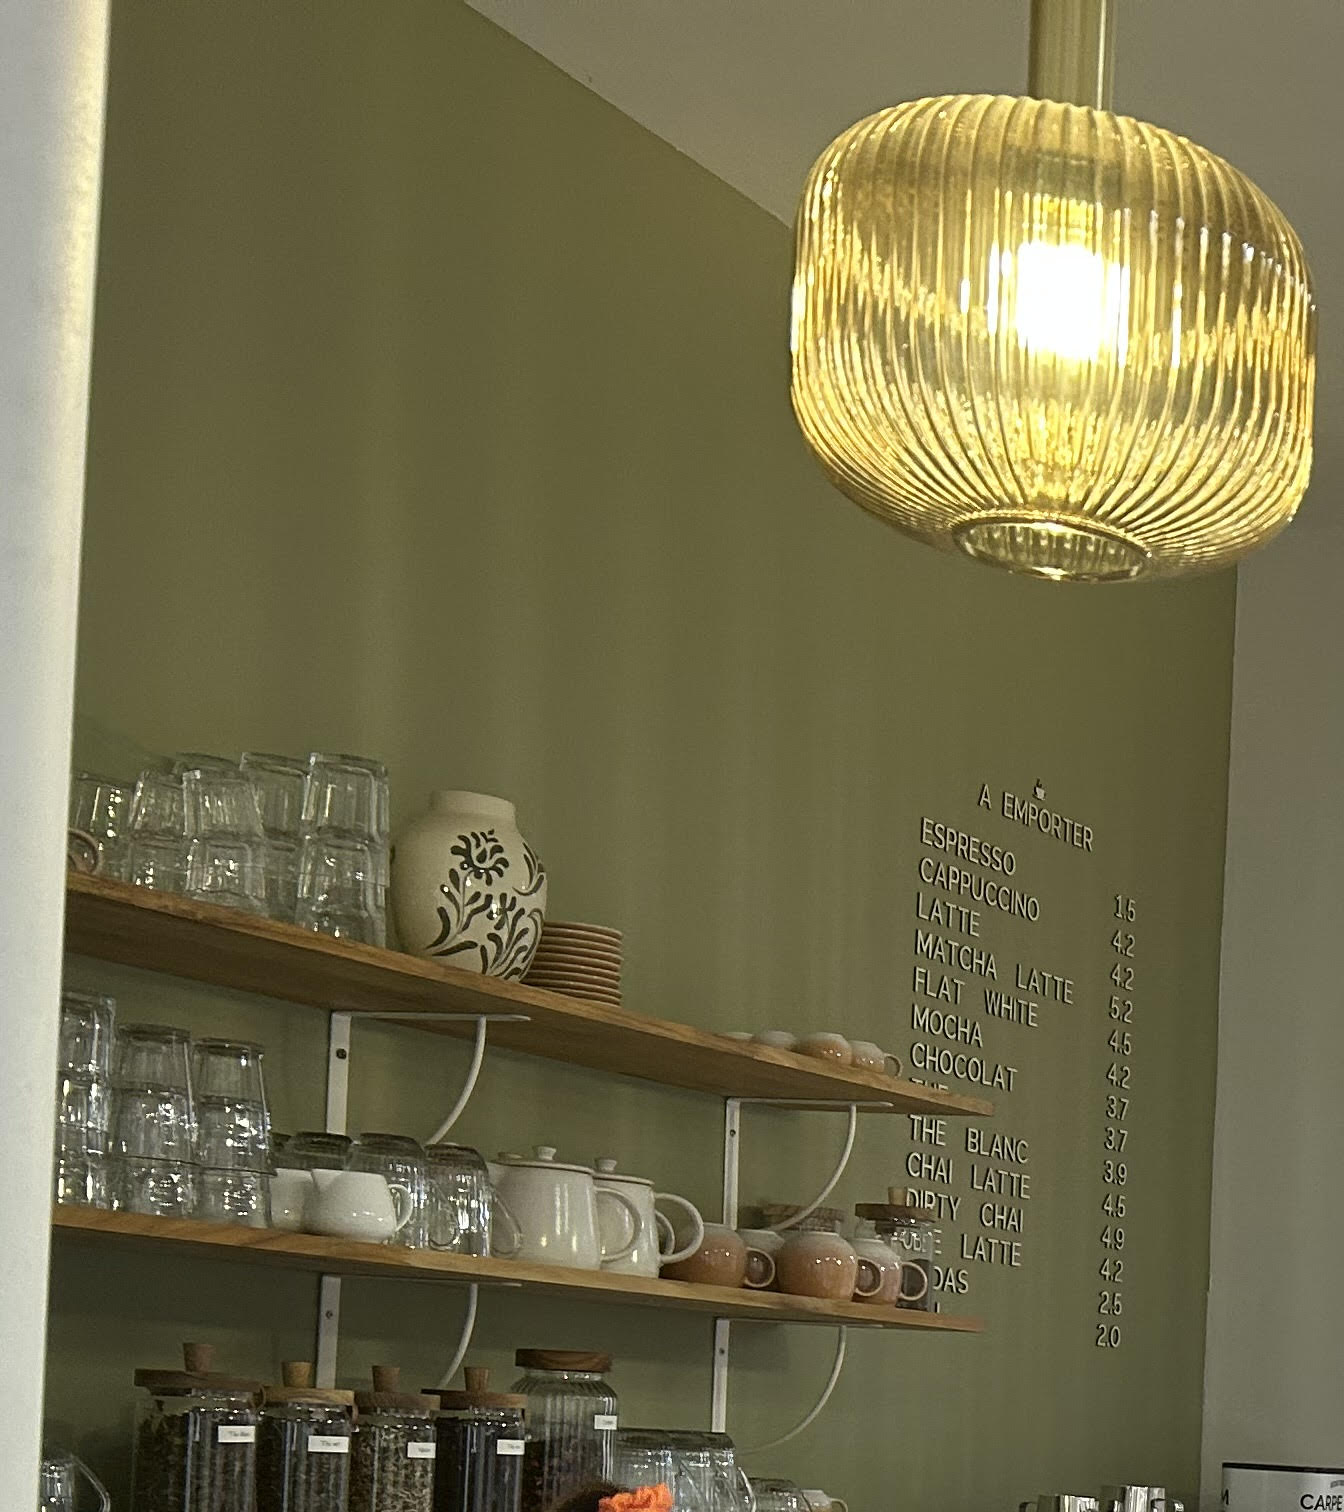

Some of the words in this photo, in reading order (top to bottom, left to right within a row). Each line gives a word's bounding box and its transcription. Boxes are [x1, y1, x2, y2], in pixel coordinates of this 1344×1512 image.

[979, 784, 992, 810] A
[1003, 792, 1094, 851] EMPORTER
[922, 817, 1016, 875] ESPRESSO
[919, 857, 1040, 921] CAPPUCCINO
[916, 892, 981, 937] LATTE
[1115, 895, 1137, 922] 1.5
[1112, 930, 1136, 958] 4.2
[915, 929, 998, 980] MATCHA
[1016, 963, 1074, 1004] LATTE
[1111, 963, 1135, 991] 4.2
[914, 966, 966, 1005] FLAT
[985, 988, 1039, 1028] WHITE
[1109, 996, 1133, 1024] 5.2
[912, 1003, 984, 1048] MOCHA
[1108, 1029, 1132, 1056] 4.5
[911, 1042, 1018, 1092] CHOCOLAT
[1106, 1062, 1131, 1089] 4.2
[1105, 1095, 1130, 1122] 3.7
[966, 1127, 1030, 1164] BLANC
[1104, 1127, 1128, 1152] 3.7
[907, 1152, 953, 1184] CHAI
[971, 1164, 1031, 1199] LATTE
[1103, 1160, 1127, 1186] 3.9
[980, 1203, 1024, 1233] CHAI
[1102, 1194, 1126, 1217] 4.5
[961, 1233, 1022, 1267] LATTE
[1101, 1225, 1125, 1250] 4.9
[1100, 1258, 1123, 1282] 4.2
[1099, 1291, 1122, 1316] 2.5
[1097, 1324, 1121, 1348] 2.0
[1300, 1493, 1343, 1512] CARPE
